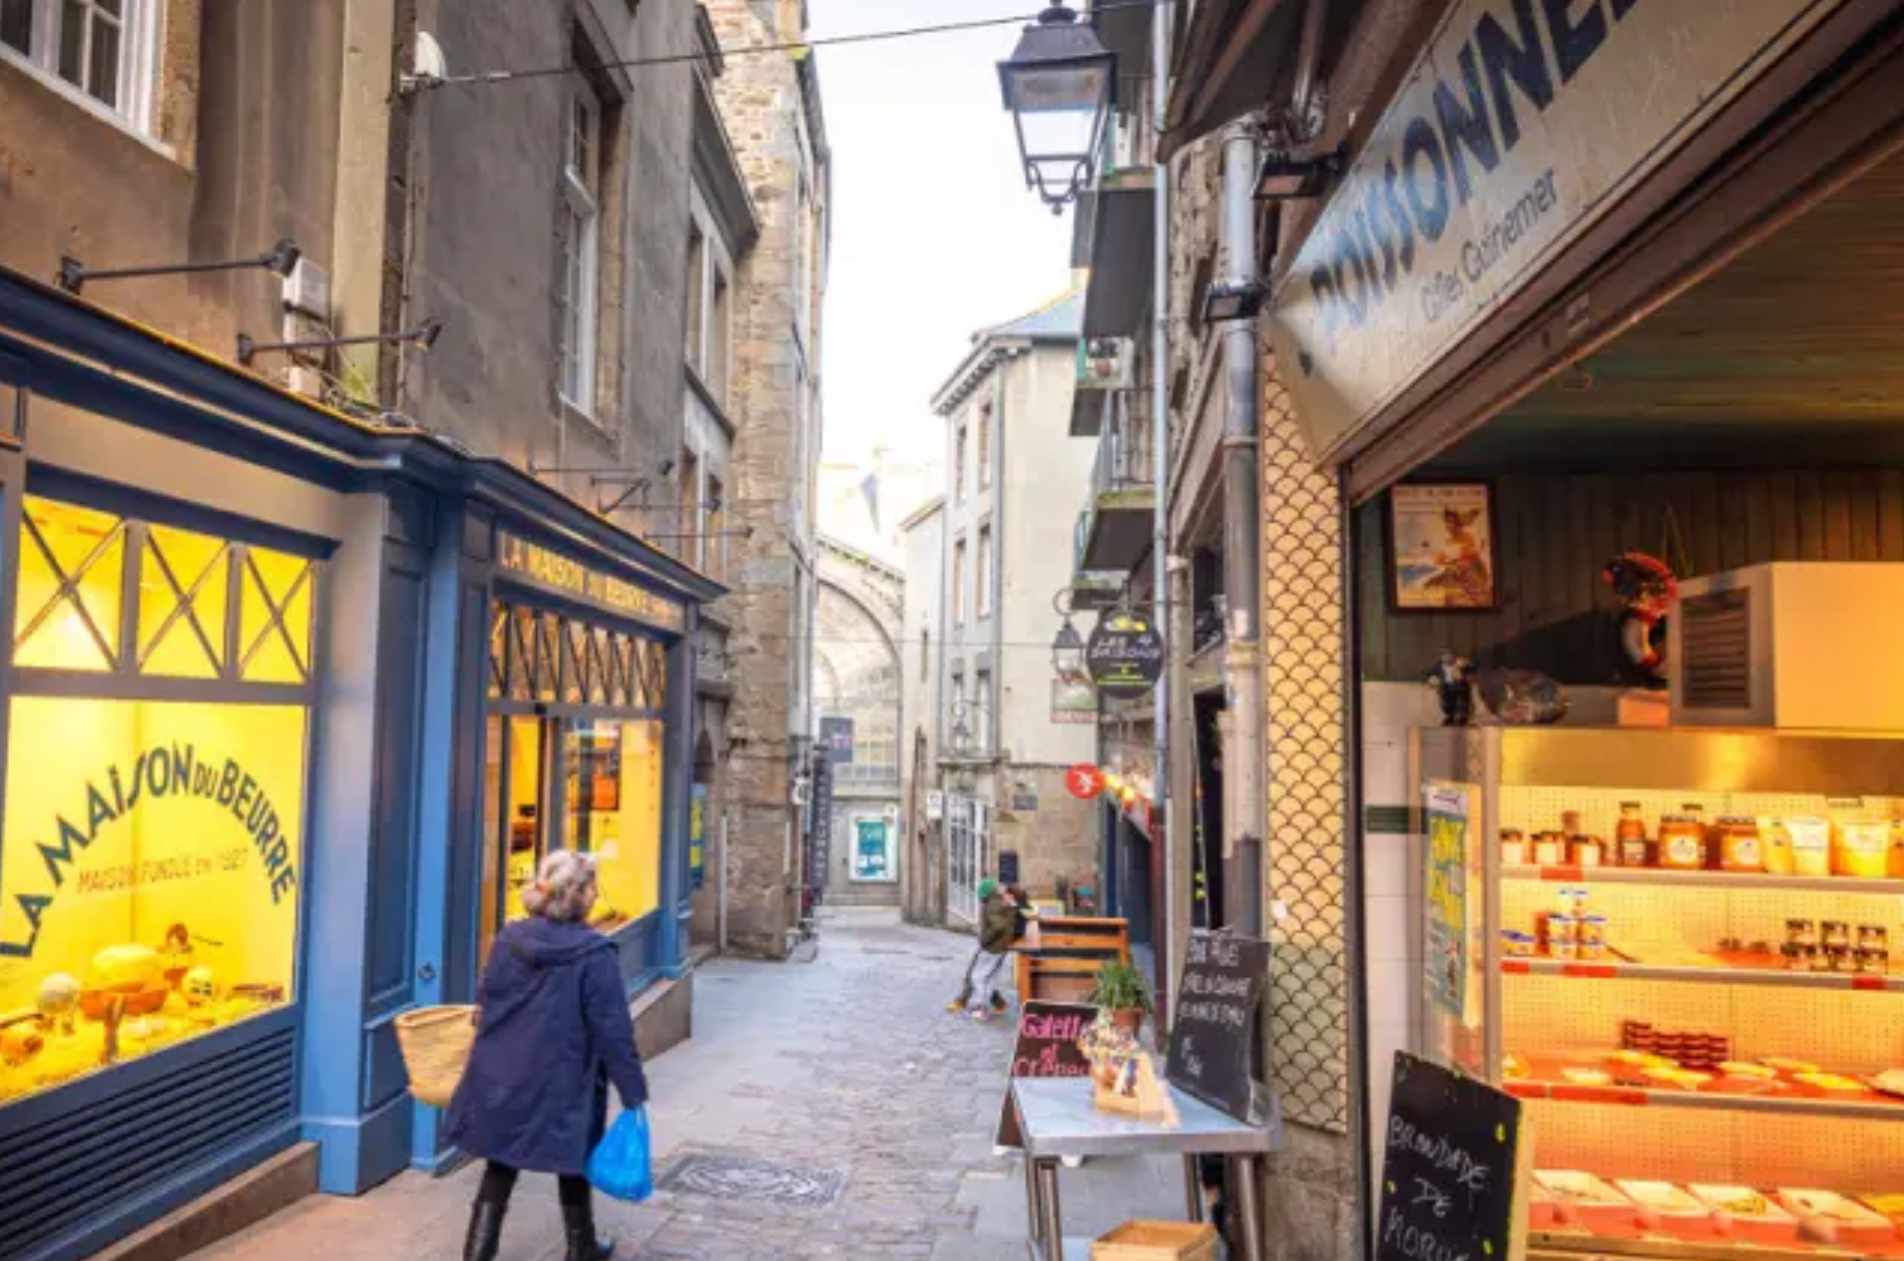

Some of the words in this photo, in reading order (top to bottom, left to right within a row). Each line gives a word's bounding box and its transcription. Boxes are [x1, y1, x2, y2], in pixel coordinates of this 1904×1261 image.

[193, 762, 219, 799] DU
[216, 757, 297, 905] BEURRE
[1411, 1177, 1452, 1218] DE
